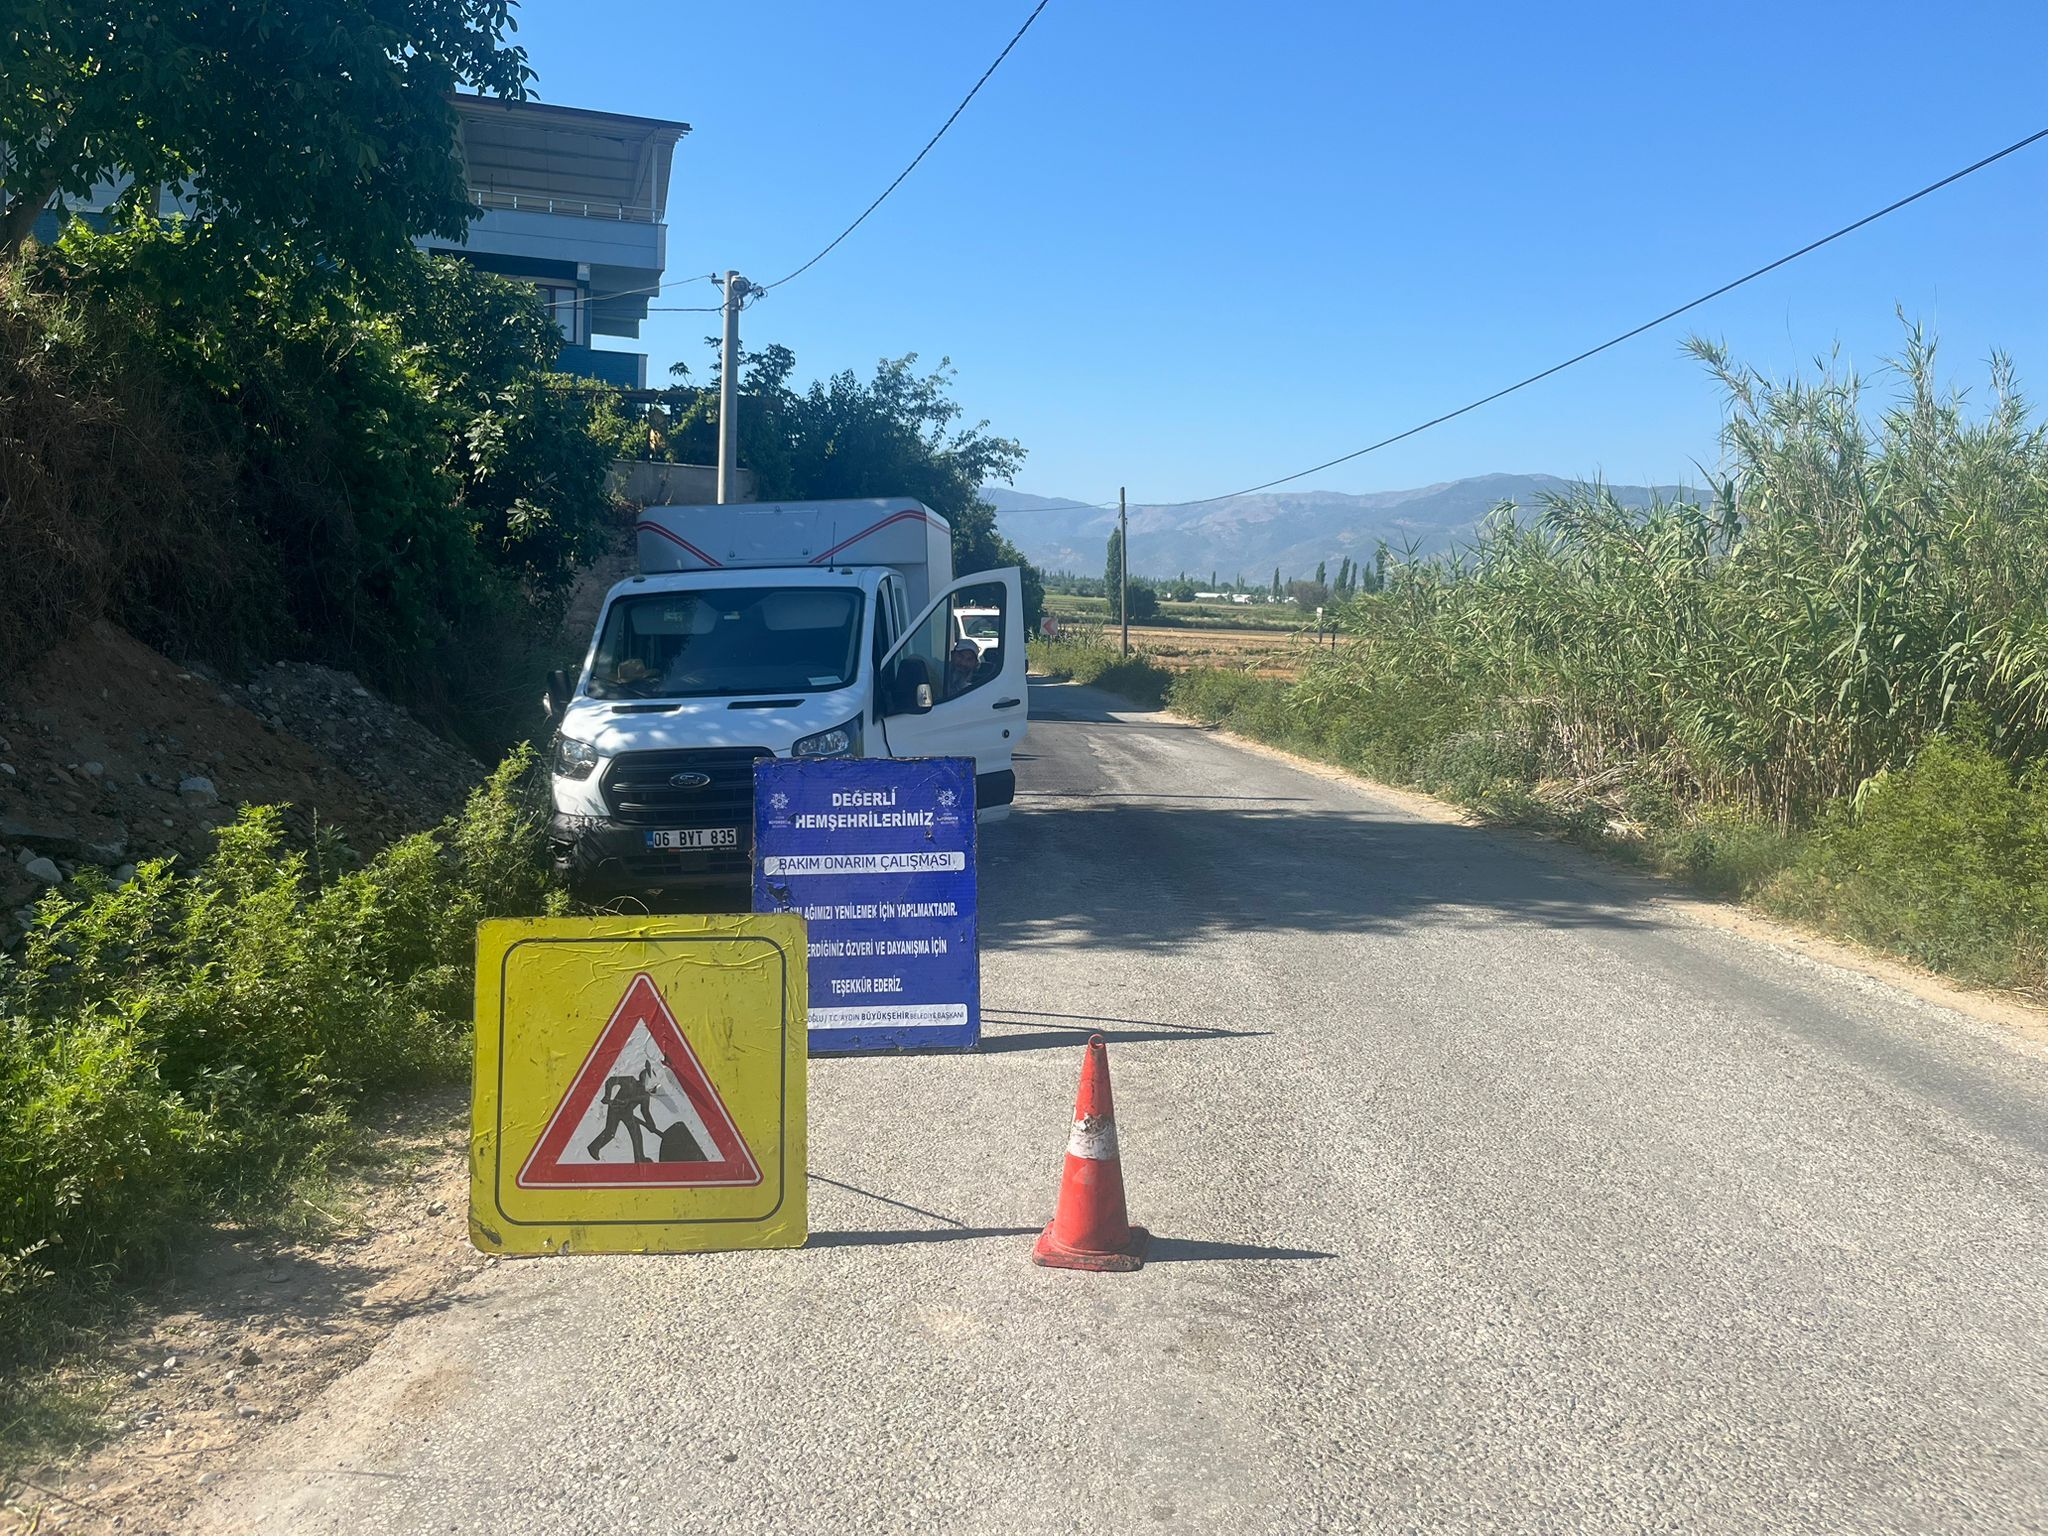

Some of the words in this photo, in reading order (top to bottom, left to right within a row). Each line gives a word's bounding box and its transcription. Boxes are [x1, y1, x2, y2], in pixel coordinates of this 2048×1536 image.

[832, 789, 896, 807] DEĞERLİ
[654, 832, 670, 847] 06
[679, 830, 703, 846] BVT
[710, 829, 735, 845] 835
[779, 857, 820, 870] BAKIM
[824, 855, 876, 869] ONARIM
[881, 853, 951, 871] ÇALIŞMASI
[804, 903, 833, 920] AĞIMIZI
[834, 901, 878, 920] YENİLEMEK
[879, 901, 895, 921] İÇİN
[807, 939, 844, 957] ERDİĞİNİZ
[846, 938, 874, 957] ÖZVERİ
[875, 941, 885, 956] VE
[887, 939, 930, 958] DAYANIŞMA
[931, 936, 947, 957] İÇİN
[831, 976, 872, 997] TEŞEKKÜR
[874, 974, 903, 993] EDERİZ.
[861, 1010, 910, 1021] BÜYÜKŞEHİR
